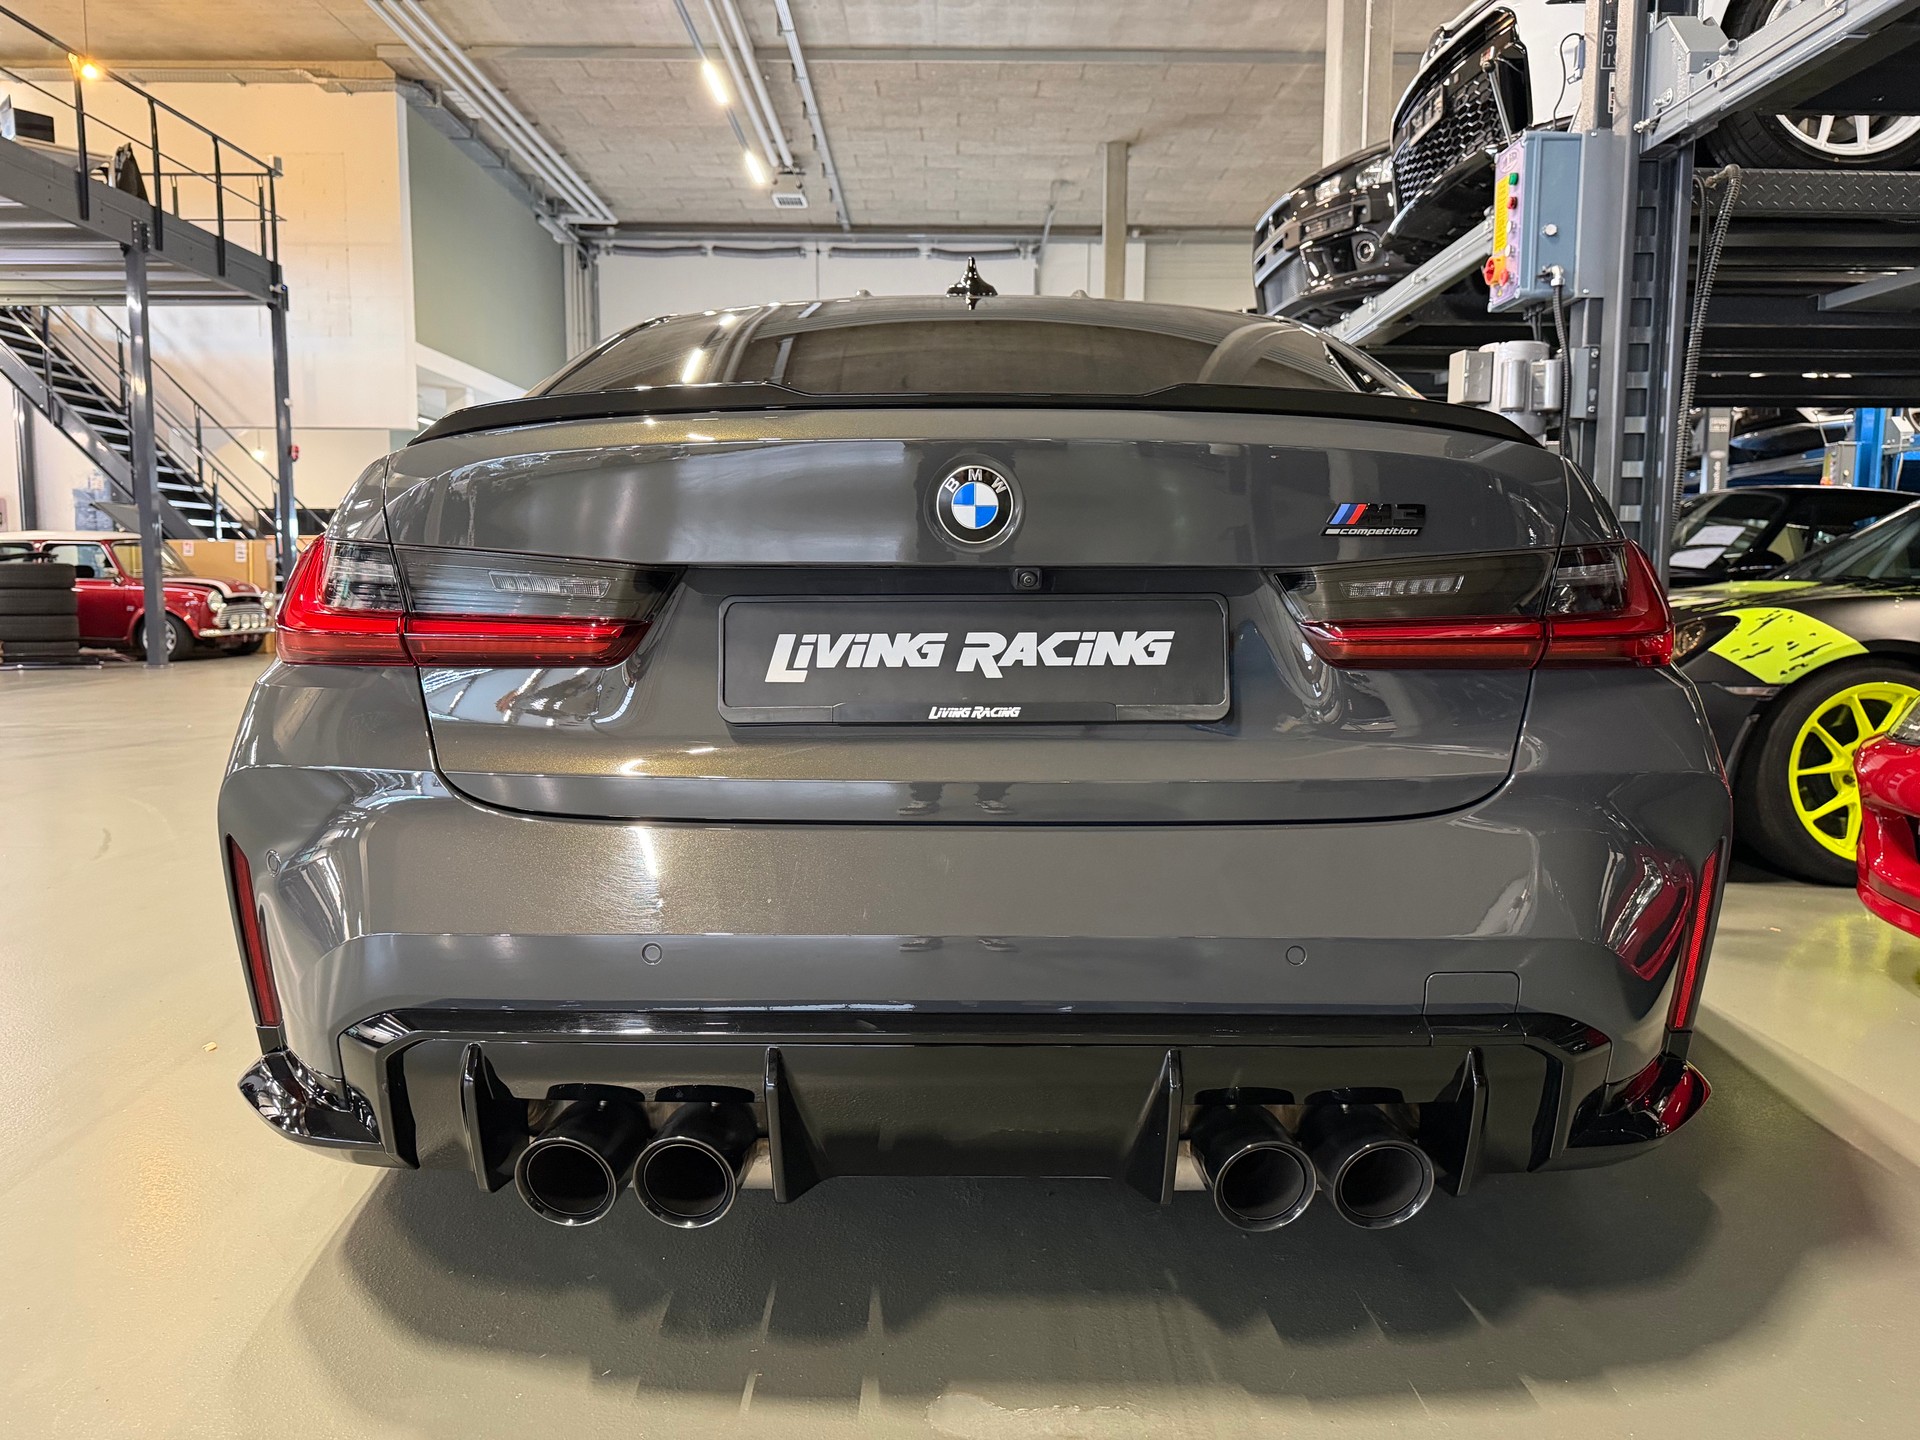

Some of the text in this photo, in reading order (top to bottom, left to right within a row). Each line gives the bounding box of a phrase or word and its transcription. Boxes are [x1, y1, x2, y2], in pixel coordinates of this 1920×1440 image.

[945, 468, 1007, 494] BMW
[1360, 503, 1427, 526] M3
[1339, 527, 1419, 536] competition
